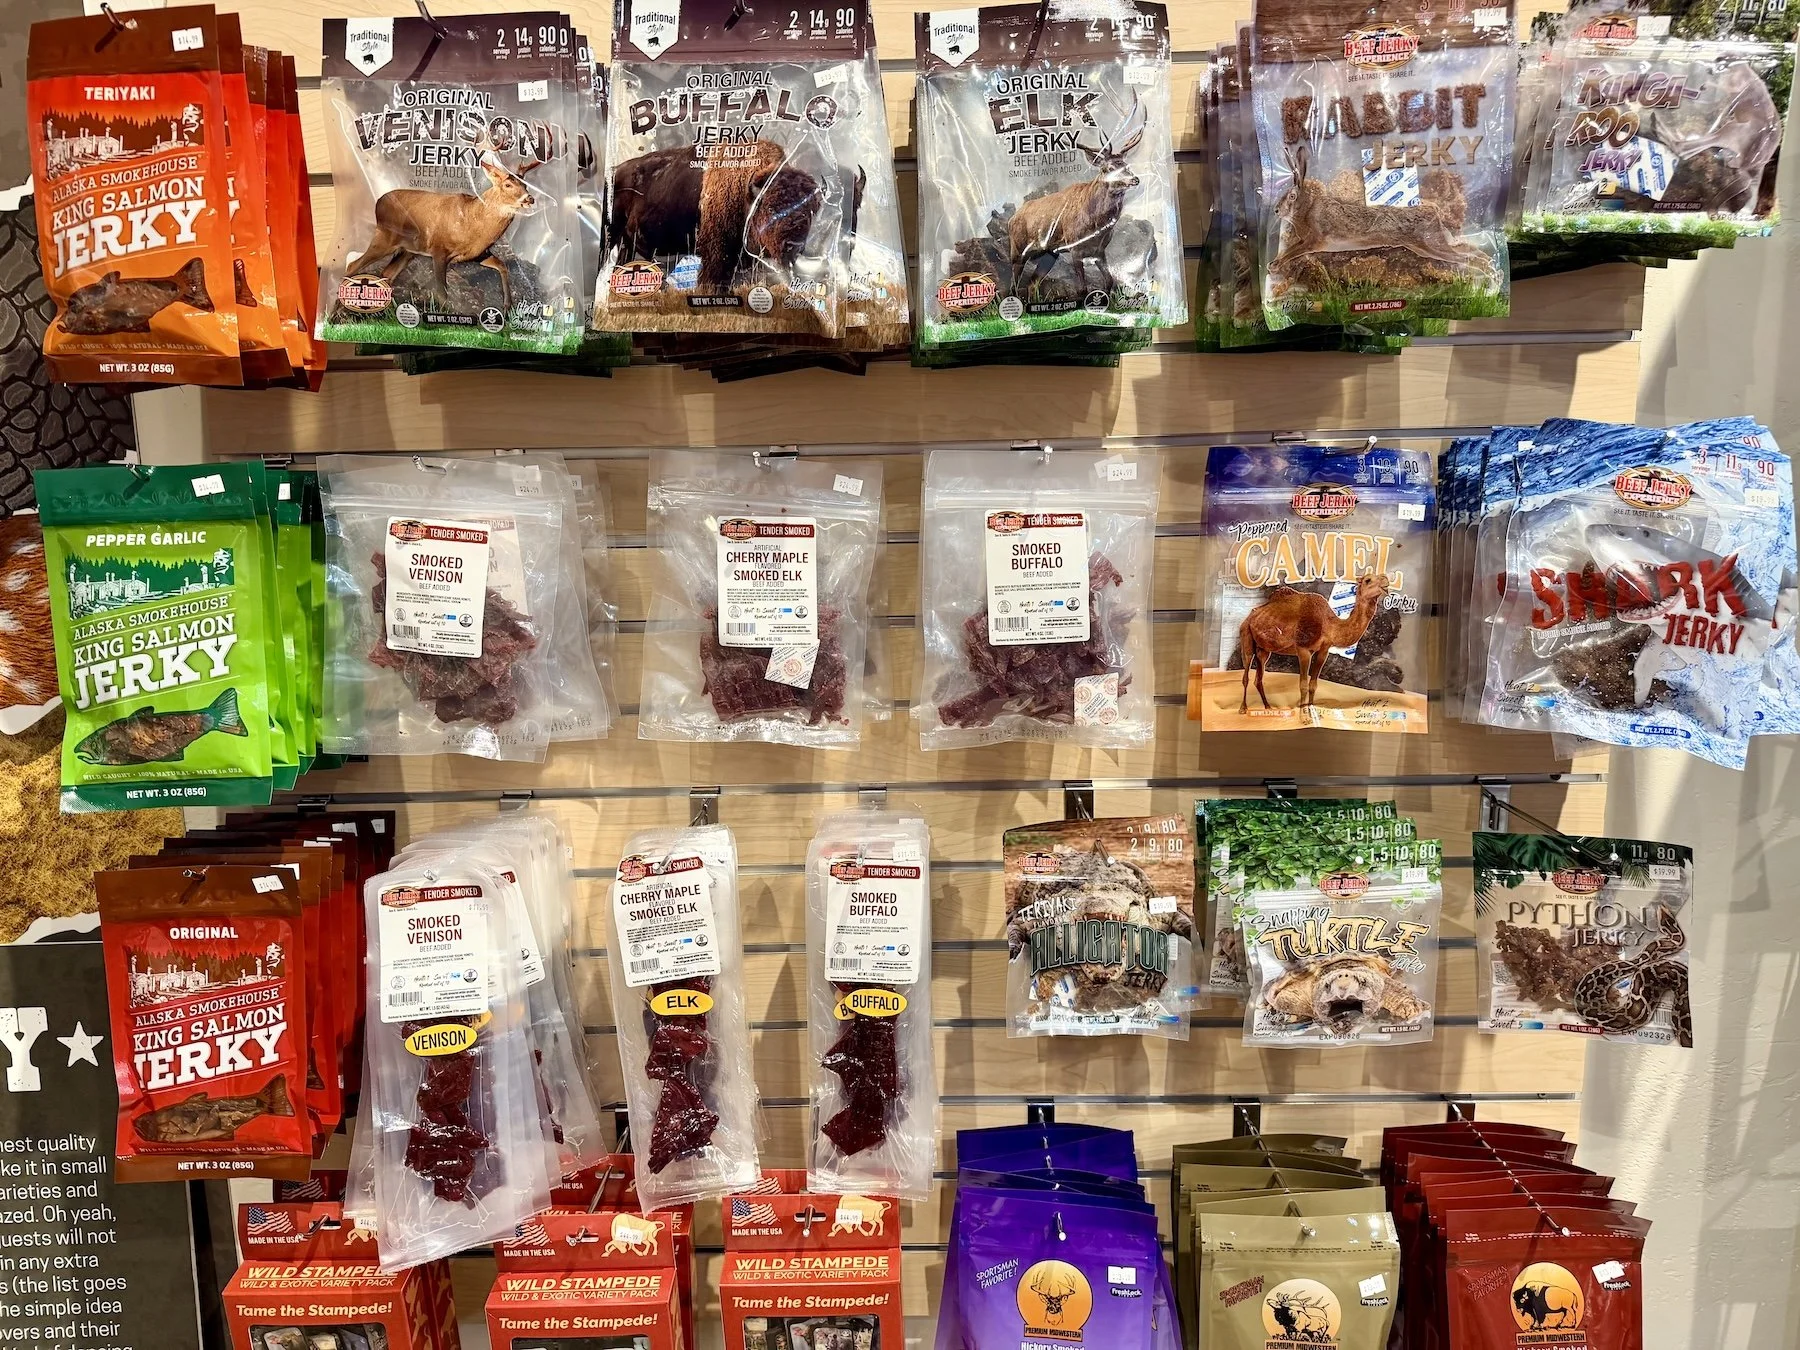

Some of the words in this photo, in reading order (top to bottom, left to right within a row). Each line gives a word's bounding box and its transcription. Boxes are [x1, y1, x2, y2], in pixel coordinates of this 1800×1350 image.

[635, 12, 676, 26] Traditional
[835, 8, 854, 27] 90
[350, 30, 390, 44] Traditional
[538, 26, 556, 45] 90
[933, 23, 975, 37] Traditional
[1354, 52, 1409, 64] EXPERIENCE
[686, 71, 773, 89] ORIGINAL
[996, 74, 1088, 93] ORIGINAL
[84, 87, 155, 101] TERIYAKI
[402, 88, 495, 110] ORIGINAL
[629, 88, 838, 136] BUFFALO
[988, 91, 1102, 135] ELK
[1282, 84, 1486, 145] RABBIT
[354, 108, 553, 164] VENISON
[692, 125, 764, 145] JERKY
[1007, 132, 1081, 154] JERKY
[409, 145, 486, 168] JERKY
[695, 146, 722, 158] BEEF
[723, 145, 757, 157] ADDED
[1013, 154, 1039, 167] BEEF
[1041, 151, 1076, 165] ADDED
[1366, 135, 1483, 171] JERKY
[52, 176, 96, 202] ALASKA
[101, 156, 198, 192] SMOKEHOUSE
[415, 166, 440, 178] BEEF
[442, 166, 477, 179] ADDED
[52, 198, 95, 231] KING
[102, 176, 205, 212] SALMON
[52, 200, 207, 278] JERKY
[345, 299, 385, 307] EXPERIENCE
[945, 296, 989, 306] EXPERIENCE
[99, 363, 115, 372] NET
[116, 363, 129, 372] WT.
[131, 364, 137, 372] 3
[138, 364, 149, 372] OZ
[151, 363, 174, 374] (85G)
[1292, 494, 1319, 506] BEEF
[1320, 493, 1356, 507] JERKY
[1027, 516, 1051, 526] TENDER
[1052, 516, 1079, 526] SMOKED
[1229, 519, 1289, 541] Peppered
[86, 534, 146, 547] PEPPER
[151, 531, 206, 545] GARLIC
[430, 528, 454, 540] TENDER
[456, 530, 484, 541] SMOKED
[760, 526, 783, 536] TENDER
[784, 526, 810, 536] SMOKED
[726, 552, 770, 562] CHERRY
[772, 552, 808, 563] MAPLE
[1012, 542, 1061, 556] SMOKED
[411, 553, 463, 569] SMOKED
[1011, 556, 1063, 570] BUFFALO
[1236, 532, 1402, 590] CAMEL
[409, 568, 463, 584] VENISON
[734, 570, 779, 582] SMOKED
[782, 570, 802, 581] ELK
[1531, 553, 1748, 629] SHARK
[1384, 594, 1417, 614] Jerky
[73, 617, 125, 640] ALASKA
[128, 596, 229, 628] SMOKEHOUSE
[73, 637, 123, 667] KING
[131, 614, 234, 649] SALMON
[1663, 613, 1744, 655] JERKY
[75, 634, 238, 711] JERKY
[127, 790, 143, 799] NET
[145, 789, 161, 798] WT.
[170, 788, 182, 796] OZ
[184, 787, 206, 797] (85G)
[1420, 844, 1436, 859] 80
[1657, 848, 1675, 860] 80
[620, 891, 661, 905] CHERRY
[665, 885, 701, 899] MAPLE
[851, 892, 897, 904] SMOKED
[629, 908, 674, 921] SMOKED
[678, 902, 698, 914] ELK
[850, 905, 898, 917] BUFFALO
[1018, 898, 1078, 922] TERIYAKI
[1505, 901, 1659, 932] PYTHON
[408, 914, 460, 930] SMOKED
[1251, 905, 1331, 935] Snapping
[170, 927, 238, 939] ORIGINAL
[407, 928, 462, 944] VENISON
[1258, 916, 1430, 961] TURTLE
[1572, 928, 1648, 948] JERKY
[1030, 919, 1169, 977] ALLIGATOR
[136, 1007, 185, 1027] ALASKA
[189, 988, 280, 1016] SMOKEHOUSE
[667, 995, 699, 1008] ELK
[852, 995, 899, 1011] BUFFALO
[133, 1025, 183, 1052] KING
[190, 1002, 285, 1038] SALMON
[1489, 1019, 1514, 1029] Sweet
[412, 1030, 467, 1050] VENISON
[38, 1133, 96, 1155] quality
[25, 1160, 37, 1175] it
[42, 1159, 57, 1174] in
[61, 1156, 106, 1174] small
[66, 1180, 97, 1197] and
[43, 1205, 66, 1222] Oh
[70, 1203, 116, 1224] yeah,
[56, 1228, 83, 1244] will
[87, 1229, 116, 1244] not
[19, 1257, 49, 1273] any
[53, 1253, 99, 1268] extra
[736, 1258, 785, 1269] WILD
[789, 1256, 888, 1269] STAMPEDE
[976, 1258, 1019, 1281] SPORTSMAN
[506, 1279, 557, 1291] WILD
[559, 1276, 661, 1289] STAMPEDE
[733, 1272, 761, 1280] WILD
[774, 1271, 811, 1279] EXOTIC
[813, 1271, 858, 1279] VARIETY
[861, 1269, 888, 1277] PACK
[980, 1272, 1014, 1289] FAVORITE
[12, 1275, 48, 1295] (the
[52, 1275, 79, 1292] list
[84, 1277, 127, 1294] goes
[25, 1298, 81, 1319] simple
[86, 1297, 122, 1314] idea
[732, 1297, 773, 1308] Tame
[777, 1296, 801, 1308] the
[805, 1293, 889, 1309] Stampede!
[44, 1321, 76, 1339] and
[80, 1320, 120, 1337] their
[499, 1317, 540, 1329] Tame
[544, 1317, 569, 1328] the
[573, 1314, 658, 1330] Stampede!
[1518, 1334, 1544, 1343] PREMIUM
[1546, 1333, 1584, 1341] MIDWESTERN
